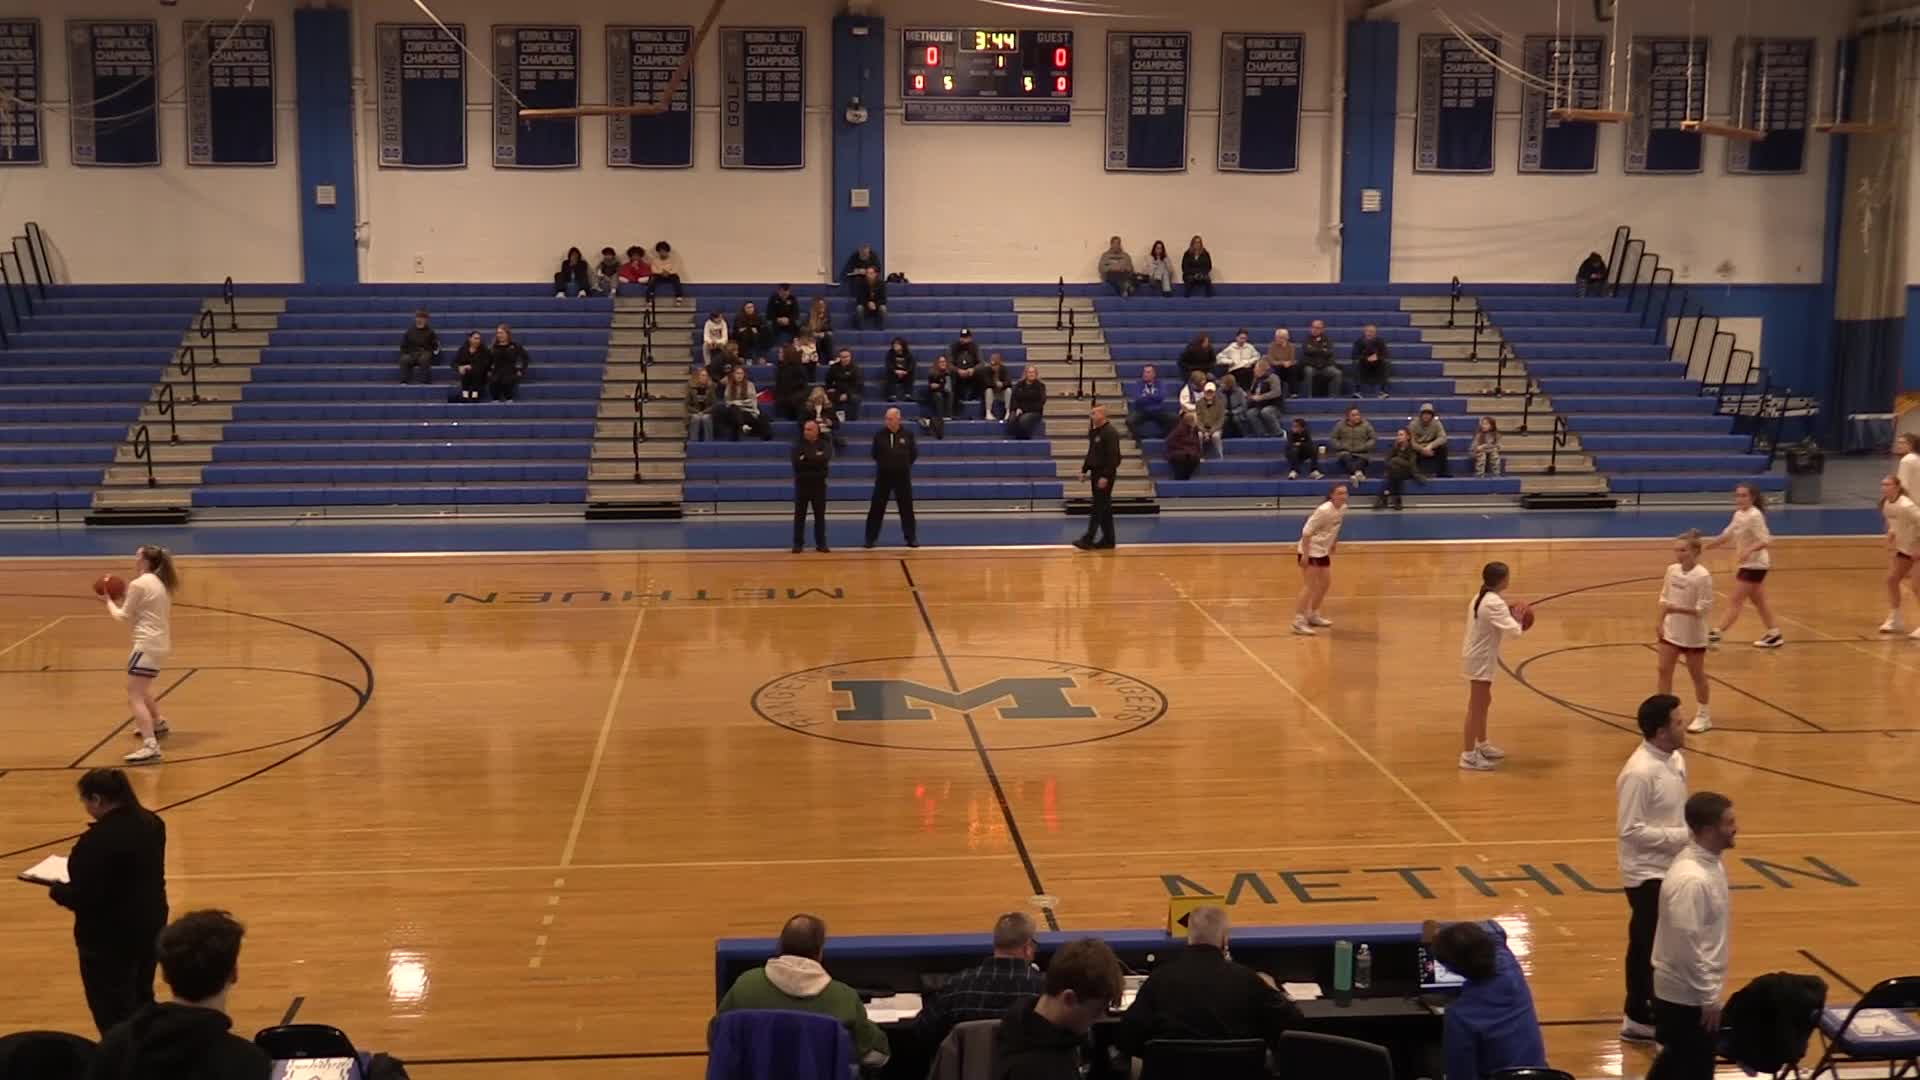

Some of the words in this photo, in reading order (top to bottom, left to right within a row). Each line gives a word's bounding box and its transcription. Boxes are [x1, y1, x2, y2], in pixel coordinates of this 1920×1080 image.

[905, 31, 953, 42] METHUEN
[975, 31, 1015, 50] 3:44
[1037, 32, 1070, 42] GUEST
[403, 53, 460, 64] CHAMPIONS
[519, 55, 574, 64] CHAMPIONS
[746, 56, 800, 66] CHAMPIONS
[926, 46, 938, 66] 0
[997, 55, 1005, 68] 1
[1055, 47, 1067, 67] 0
[1132, 60, 1185, 70] CHAMPIONS
[1247, 62, 1298, 72] CHAMPIONS
[915, 75, 924, 89] 0
[943, 75, 953, 90] 5
[1023, 76, 1033, 91] 5
[1056, 76, 1066, 90] 0
[727, 72, 740, 127] GOLF
[445, 587, 844, 604] METHUEN
[828, 675, 1099, 723] M
